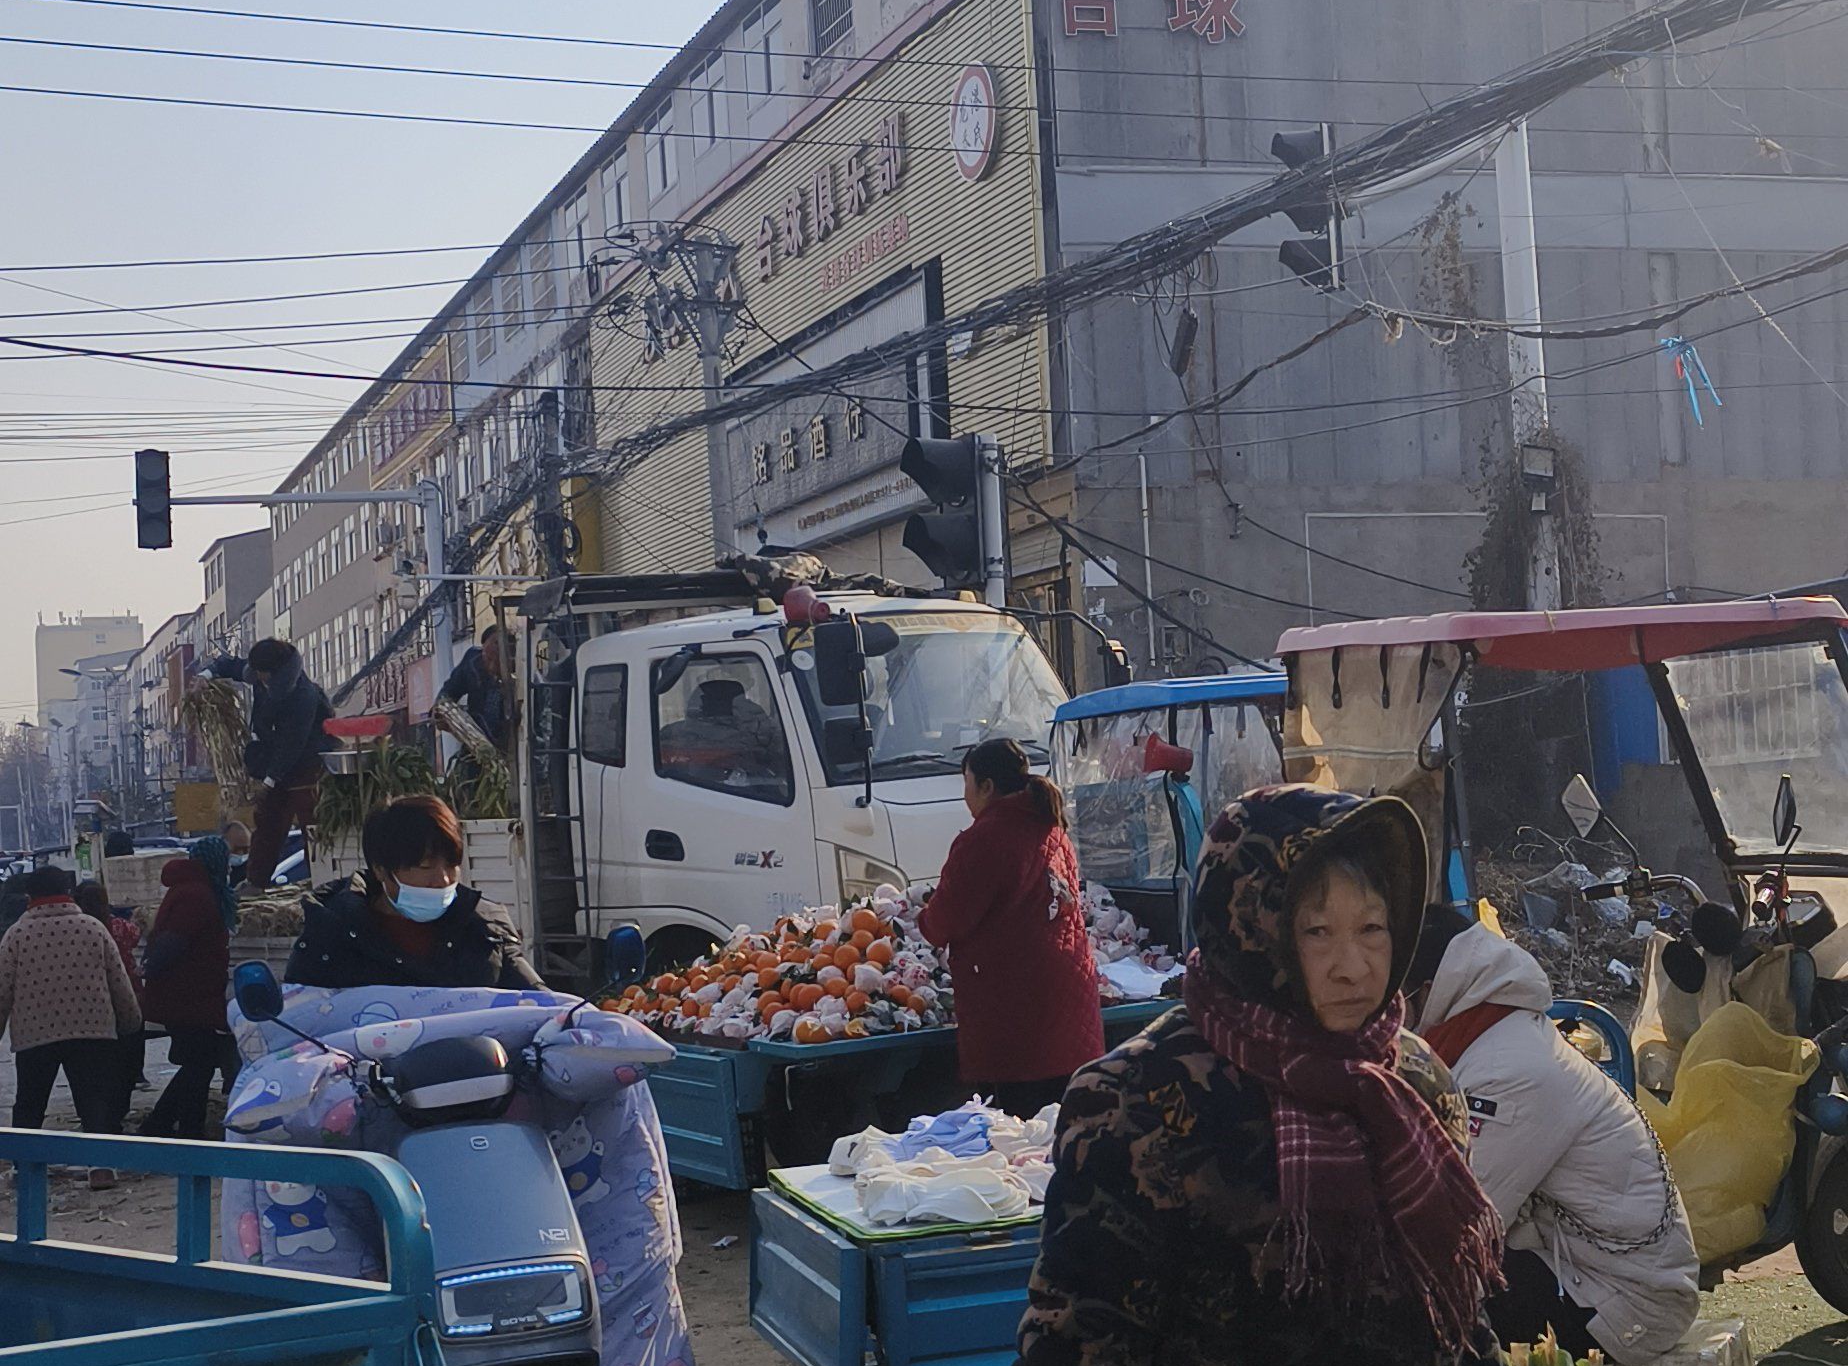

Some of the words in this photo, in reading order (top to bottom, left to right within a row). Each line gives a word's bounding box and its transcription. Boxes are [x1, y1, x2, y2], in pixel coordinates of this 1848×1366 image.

[756, 109, 904, 283] 台球俱乐部
[753, 398, 864, 486] 铭品酒行
